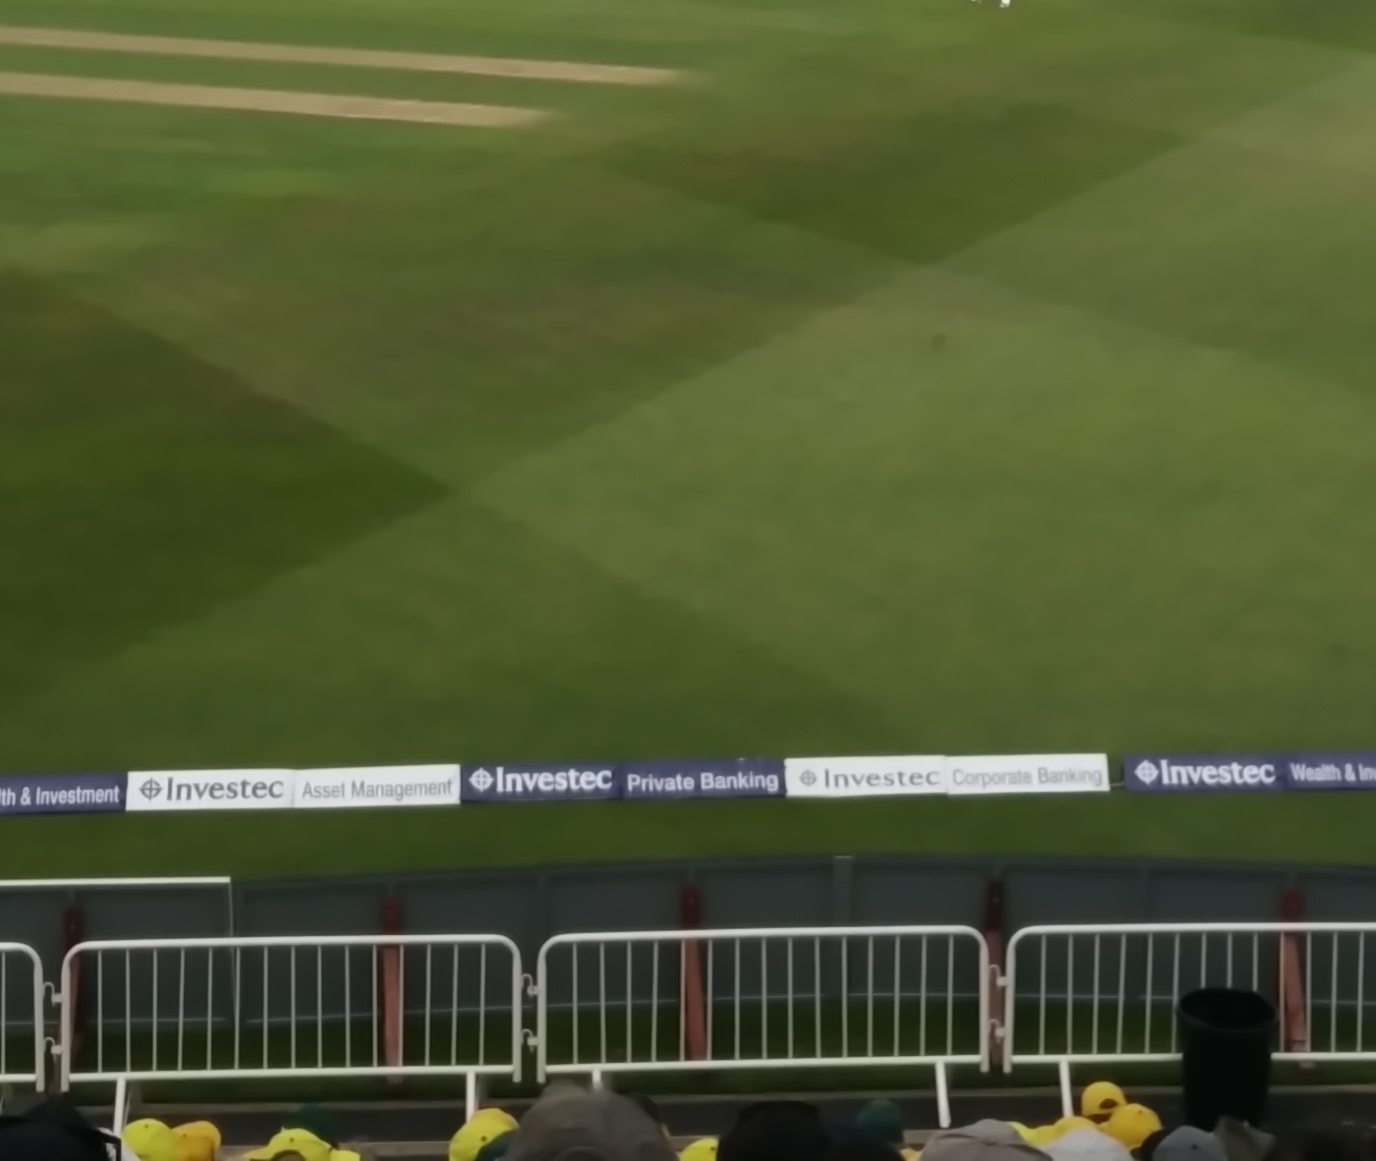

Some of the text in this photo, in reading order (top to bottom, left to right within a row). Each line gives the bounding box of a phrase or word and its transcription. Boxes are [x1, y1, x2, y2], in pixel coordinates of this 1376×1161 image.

[496, 767, 778, 793] Investec Private Banking
[824, 767, 1102, 789] Investec Corporate Banking
[1161, 759, 1276, 786] Investec
[1291, 763, 1341, 781] Wealth
[1344, 763, 1355, 781] &
[20, 788, 32, 806] &
[36, 785, 120, 805] Investment
[166, 777, 453, 801] Investec Asset Management
